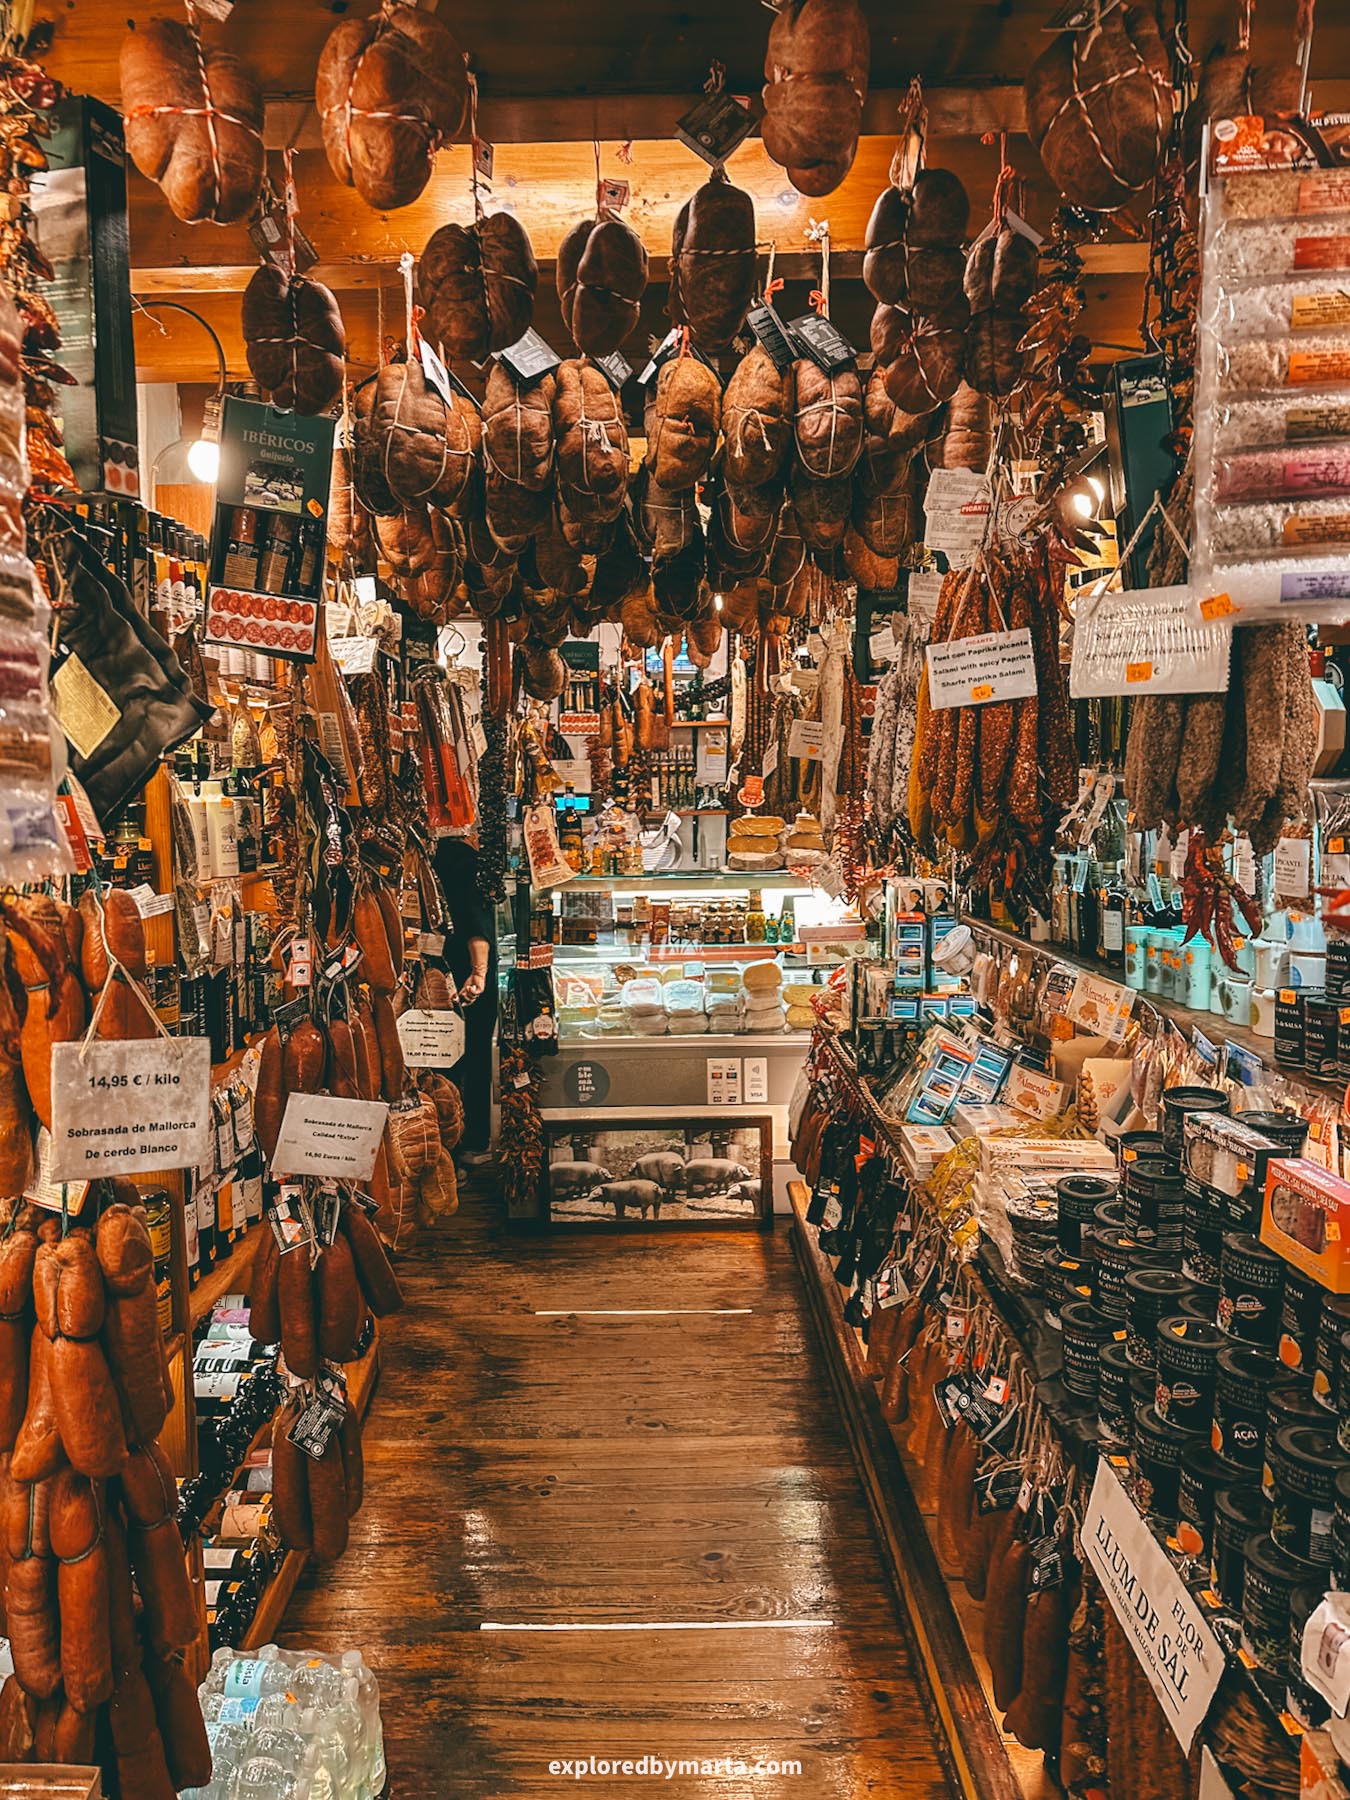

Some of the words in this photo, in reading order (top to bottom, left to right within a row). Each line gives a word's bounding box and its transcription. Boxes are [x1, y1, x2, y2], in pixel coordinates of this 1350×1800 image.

[242, 429, 315, 454] IBÉRICOS
[933, 655, 950, 663] Fuet
[968, 646, 997, 657] Paprika
[999, 640, 1029, 651] picante
[934, 667, 959, 676] Salami
[960, 664, 977, 672] with
[980, 659, 1000, 669] spicy
[1002, 654, 1032, 664] Paprika
[942, 680, 966, 688] Sharfe
[968, 674, 997, 684] Paprika
[999, 668, 1026, 678] Salami
[88, 1075, 129, 1090] 14,95
[132, 1075, 142, 1086] €
[154, 1074, 181, 1085] kilo
[578, 1084, 596, 1092] tics
[1021, 1078, 1052, 1098] Almendro
[67, 1124, 129, 1139] Sobrasada
[132, 1123, 146, 1133] de
[149, 1120, 197, 1132] Mallorca
[304, 1118, 336, 1127] Sobrasada
[346, 1123, 373, 1132] Mallorca
[312, 1131, 336, 1139] Calidad
[85, 1150, 100, 1160] De
[104, 1146, 137, 1158] cerdo
[140, 1144, 178, 1155] Blanco
[322, 1153, 341, 1161] Euros
[1039, 1157, 1071, 1166] Almendro
[1234, 1430, 1259, 1441] AÇAI
[1096, 1515, 1139, 1600] LLUM
[1134, 1588, 1161, 1643] DE
[1158, 1634, 1189, 1702] SAL
[1171, 1598, 1204, 1662] FLOR
[1133, 1622, 1157, 1670] MALLORCA
[1175, 1633, 1189, 1659] DE
